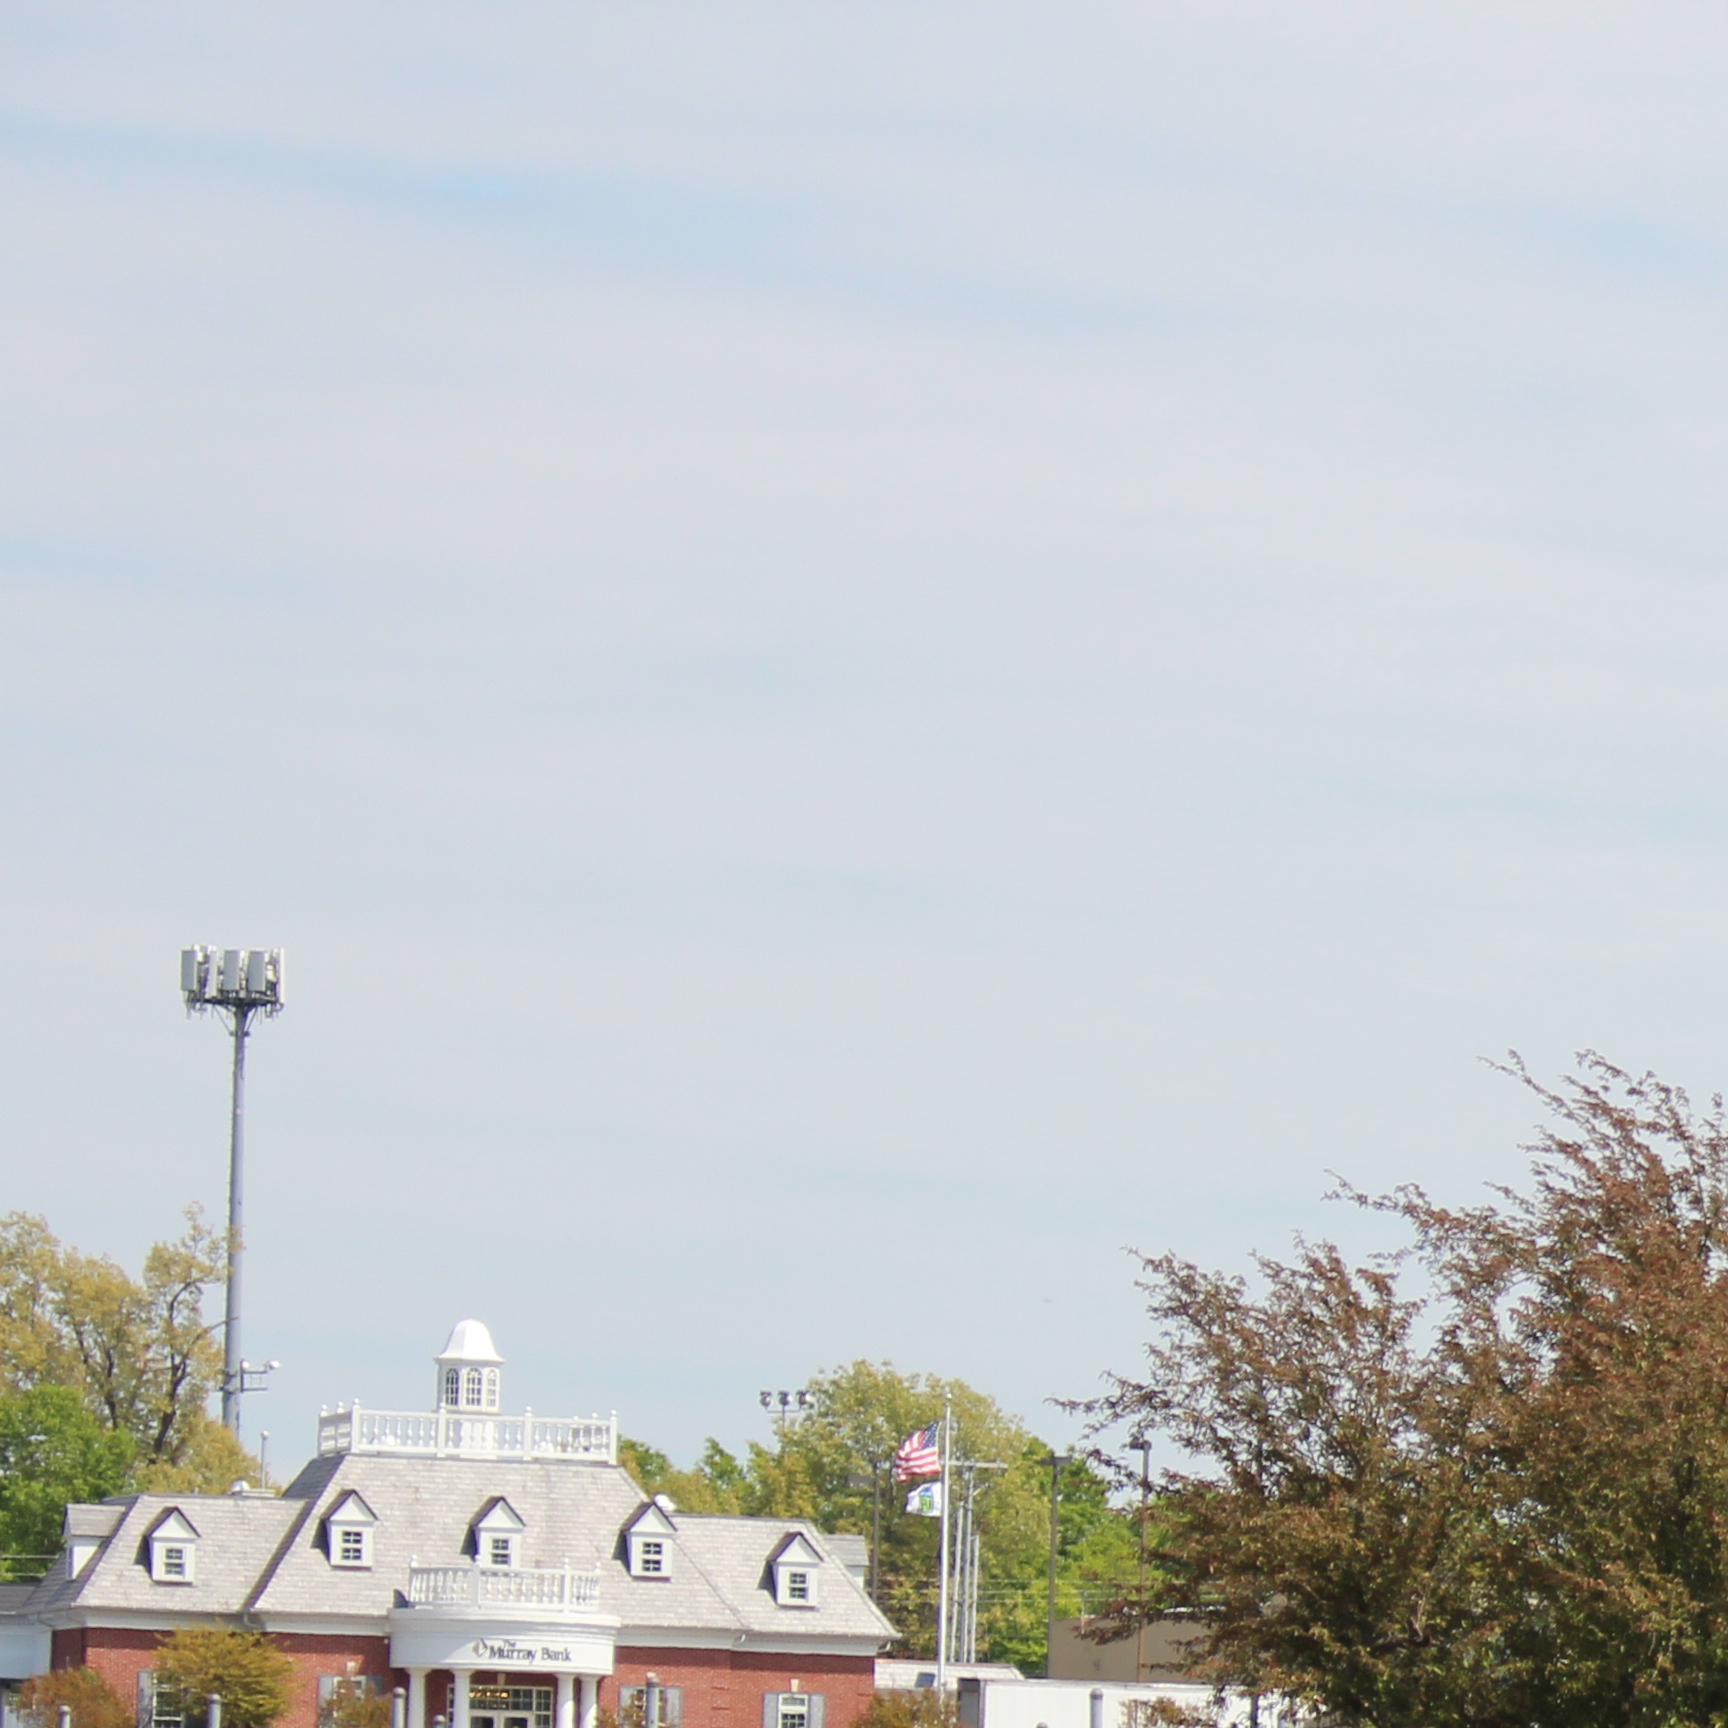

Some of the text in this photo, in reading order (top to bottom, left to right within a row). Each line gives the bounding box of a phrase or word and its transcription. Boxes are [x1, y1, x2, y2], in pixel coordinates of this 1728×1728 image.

[501, 1639, 517, 1648] The
[489, 1645, 572, 1665] Murray Bank
